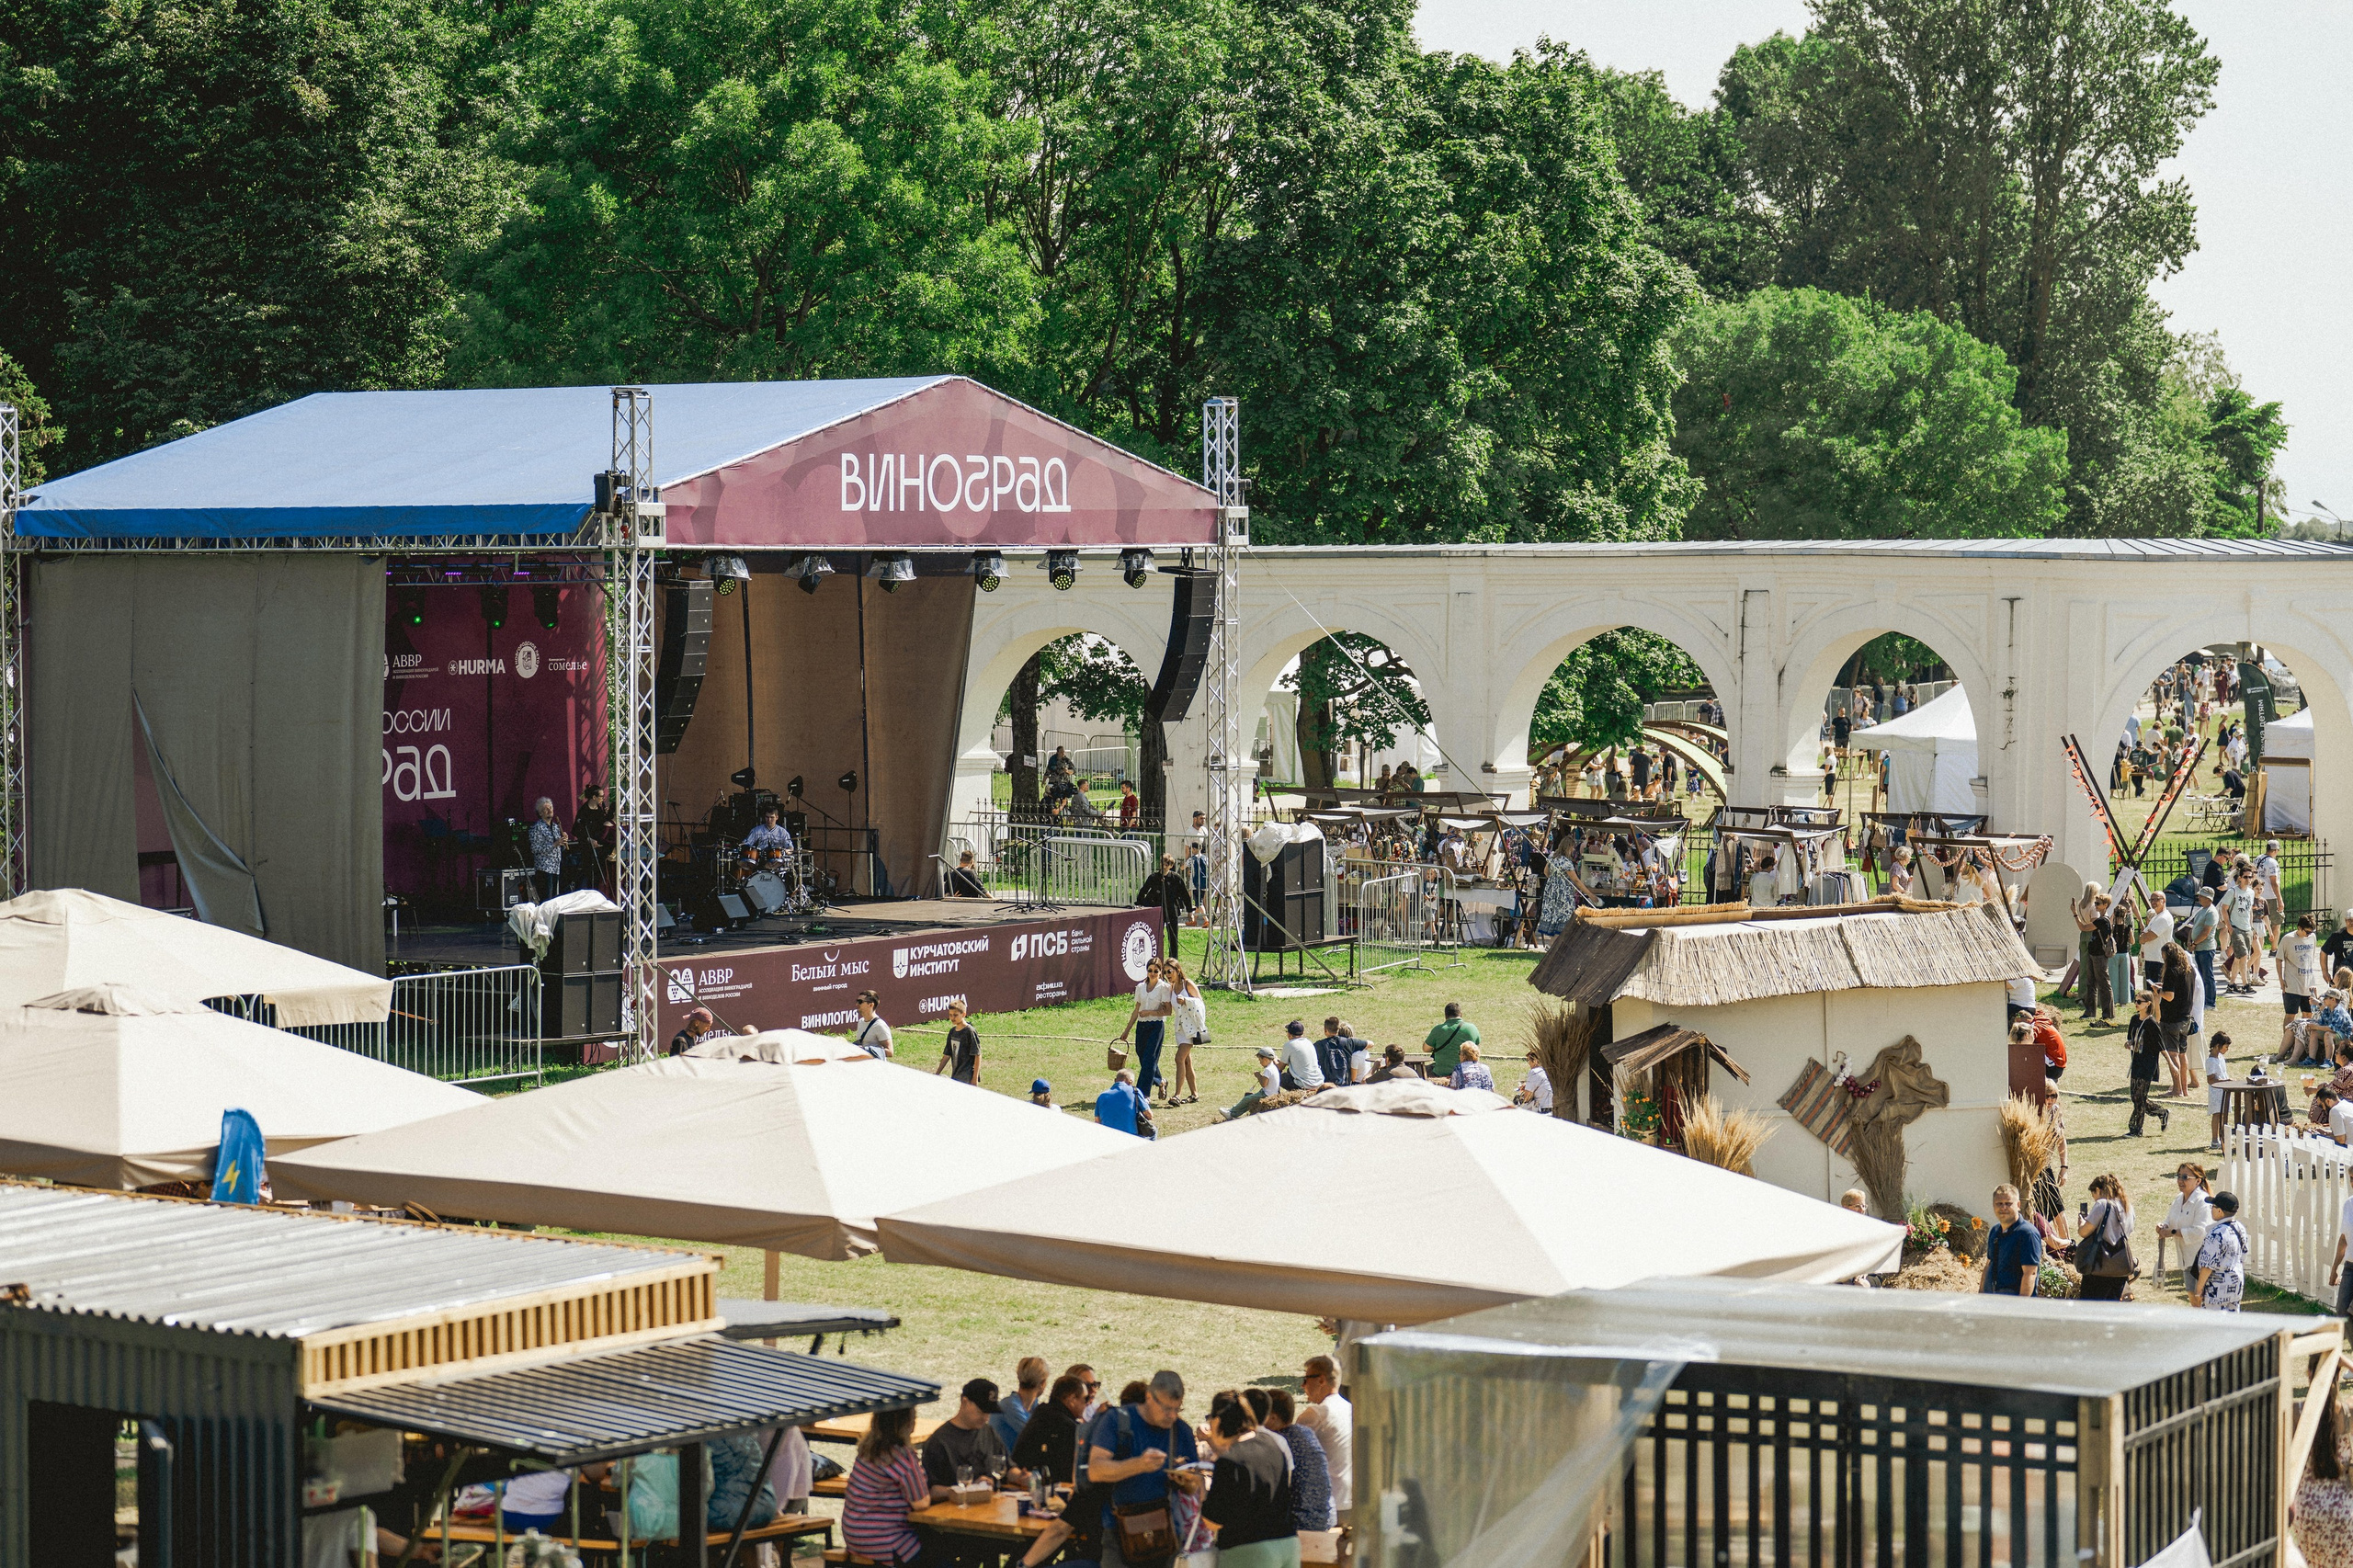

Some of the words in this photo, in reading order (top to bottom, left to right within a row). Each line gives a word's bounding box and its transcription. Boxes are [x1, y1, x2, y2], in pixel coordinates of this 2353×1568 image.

[459, 658, 506, 676] HURMA
[382, 708, 450, 734] ОССИИ
[1071, 929, 1085, 937] банк
[1071, 935, 1093, 946] сильной
[1120, 921, 1153, 960] НОВГОРОДСКОЕ
[910, 935, 989, 960] КУРЧАТОВСКИЙ
[1030, 930, 1068, 959] ПСБ
[1071, 945, 1090, 954] страны
[840, 960, 870, 976] мыс
[910, 959, 961, 978] ИНСТИТУТ
[832, 983, 848, 991] город
[1036, 982, 1063, 991] афиша
[1035, 990, 1068, 1002] рестораны
[801, 1009, 859, 1029] ВИНОЛОГИЯ
